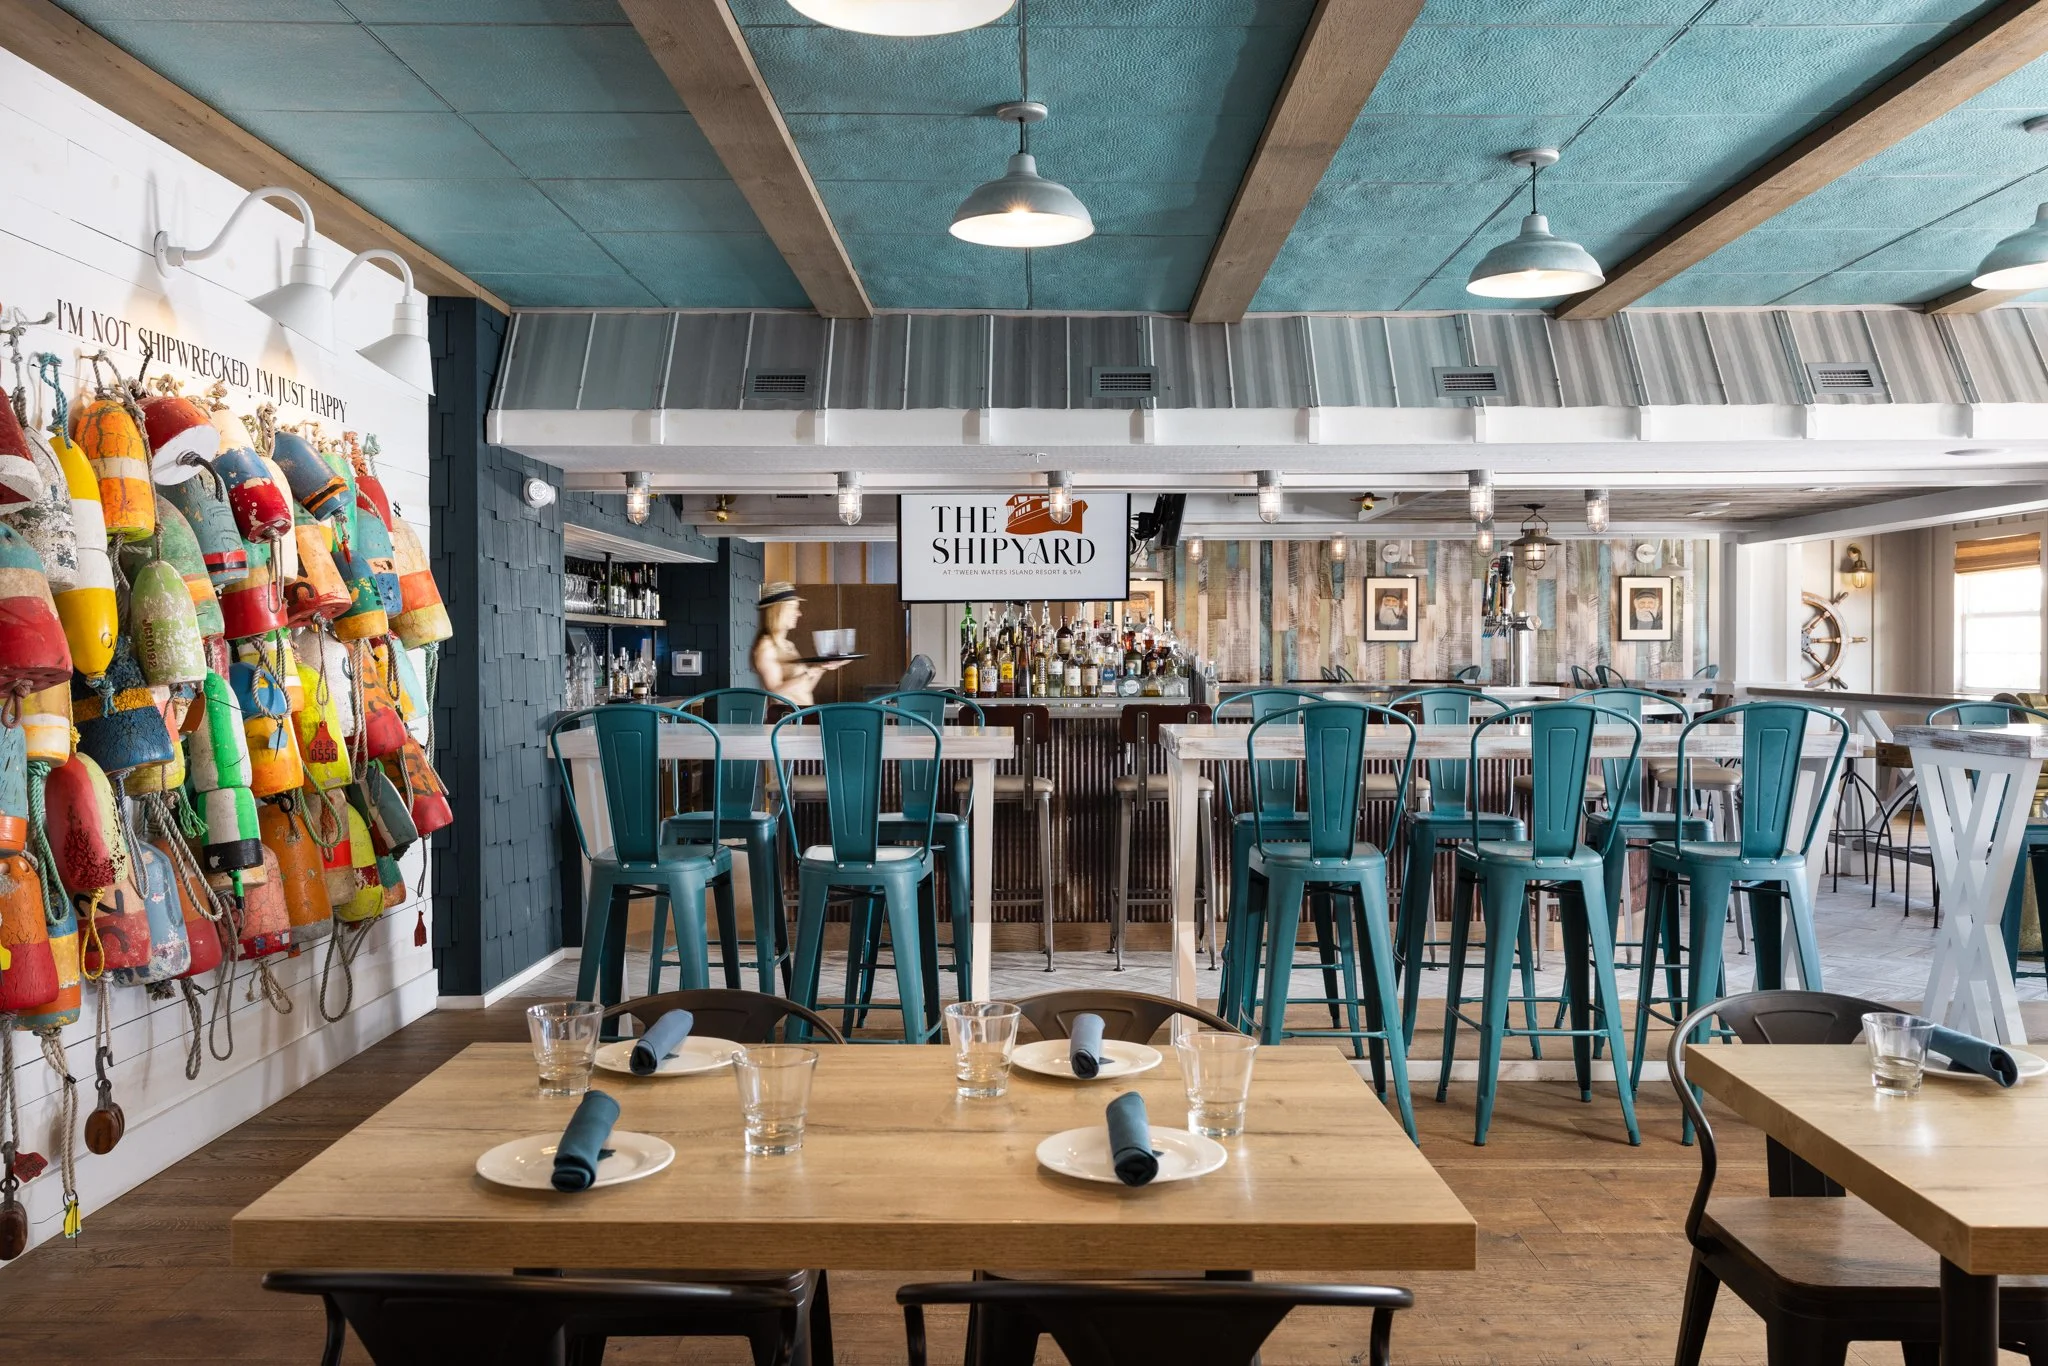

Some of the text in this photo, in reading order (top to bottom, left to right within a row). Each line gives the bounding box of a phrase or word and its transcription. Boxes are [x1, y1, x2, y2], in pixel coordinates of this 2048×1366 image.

[57, 298, 84, 337] I'M
[91, 310, 132, 351] NOT
[256, 367, 274, 397] I'M
[278, 376, 306, 406] JUST
[310, 388, 348, 423] HAPPY
[931, 505, 997, 534] THE
[932, 537, 1096, 567] SHIPYARD
[311, 748, 337, 761] 0556
